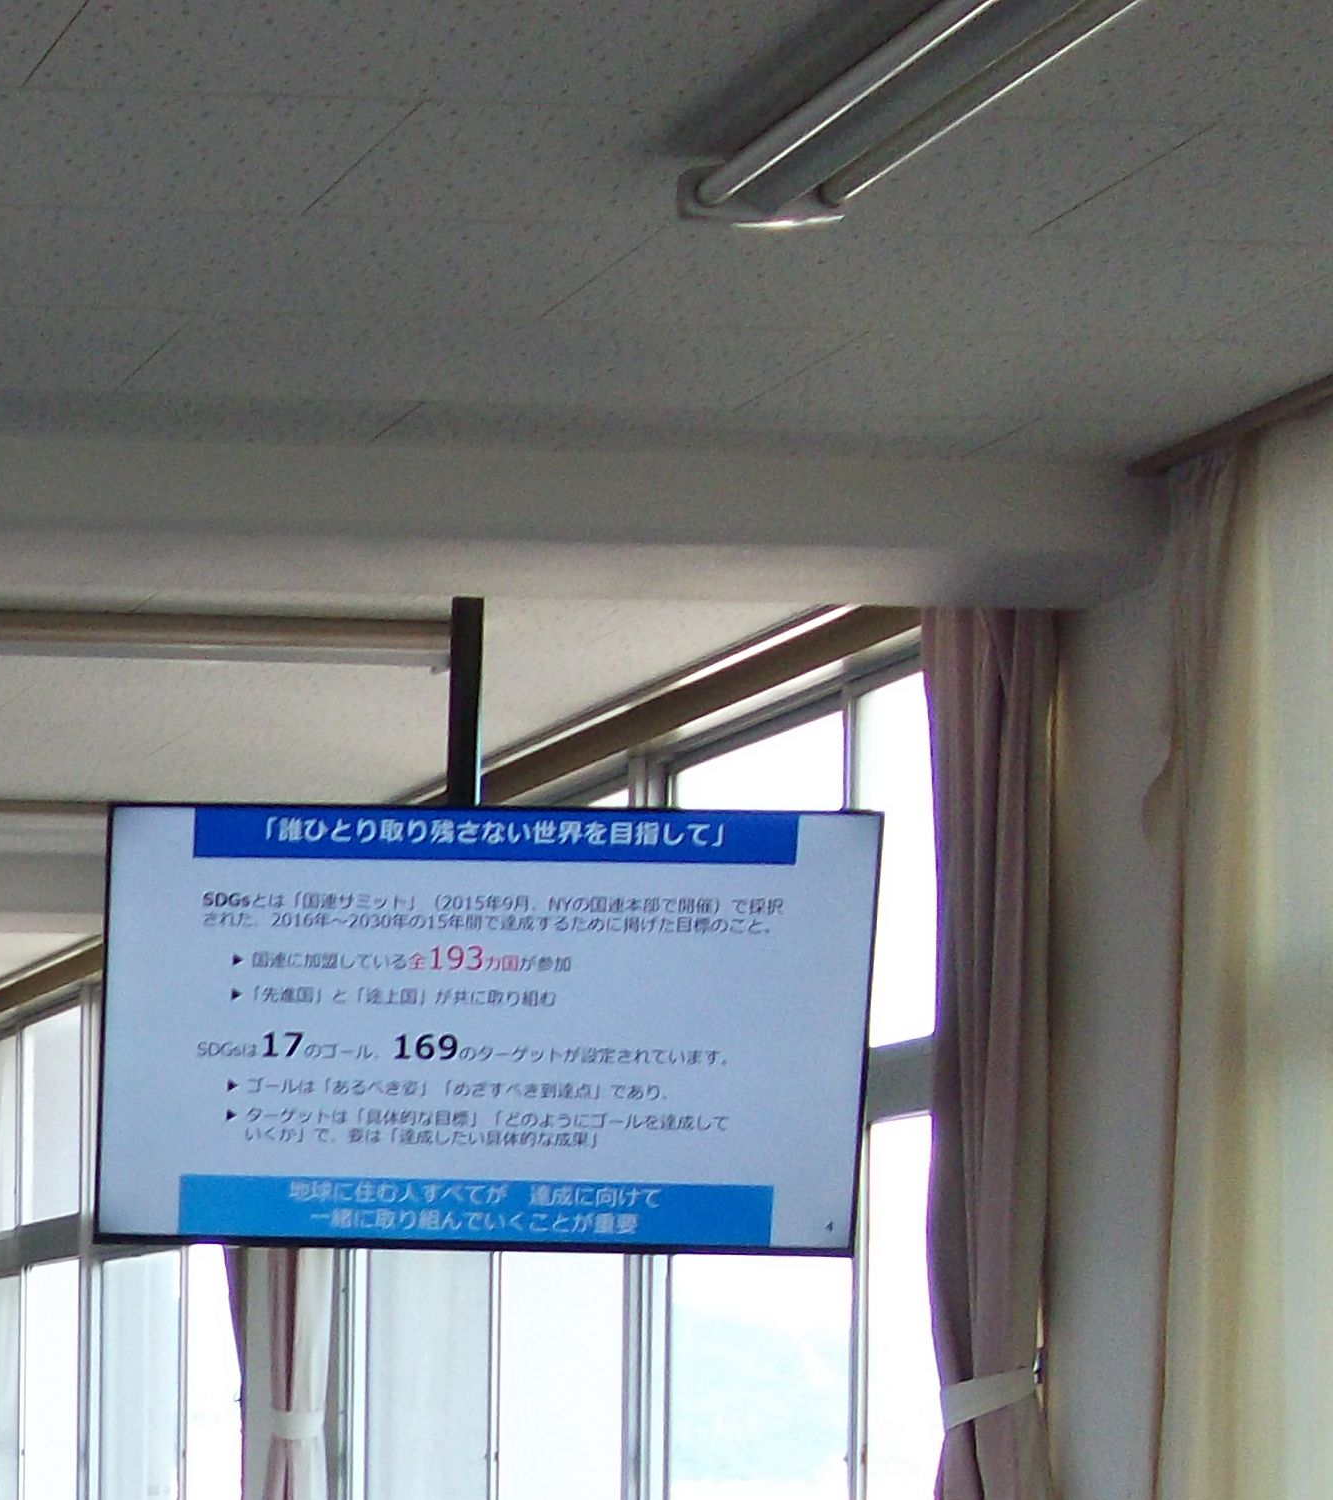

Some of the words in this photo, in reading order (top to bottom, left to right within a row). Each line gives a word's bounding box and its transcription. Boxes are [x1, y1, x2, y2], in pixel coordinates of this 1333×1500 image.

[265, 816, 724, 847] 「誰ひとり取り残さない世界を目指して」
[529, 1184, 661, 1208] 達成に向けて
